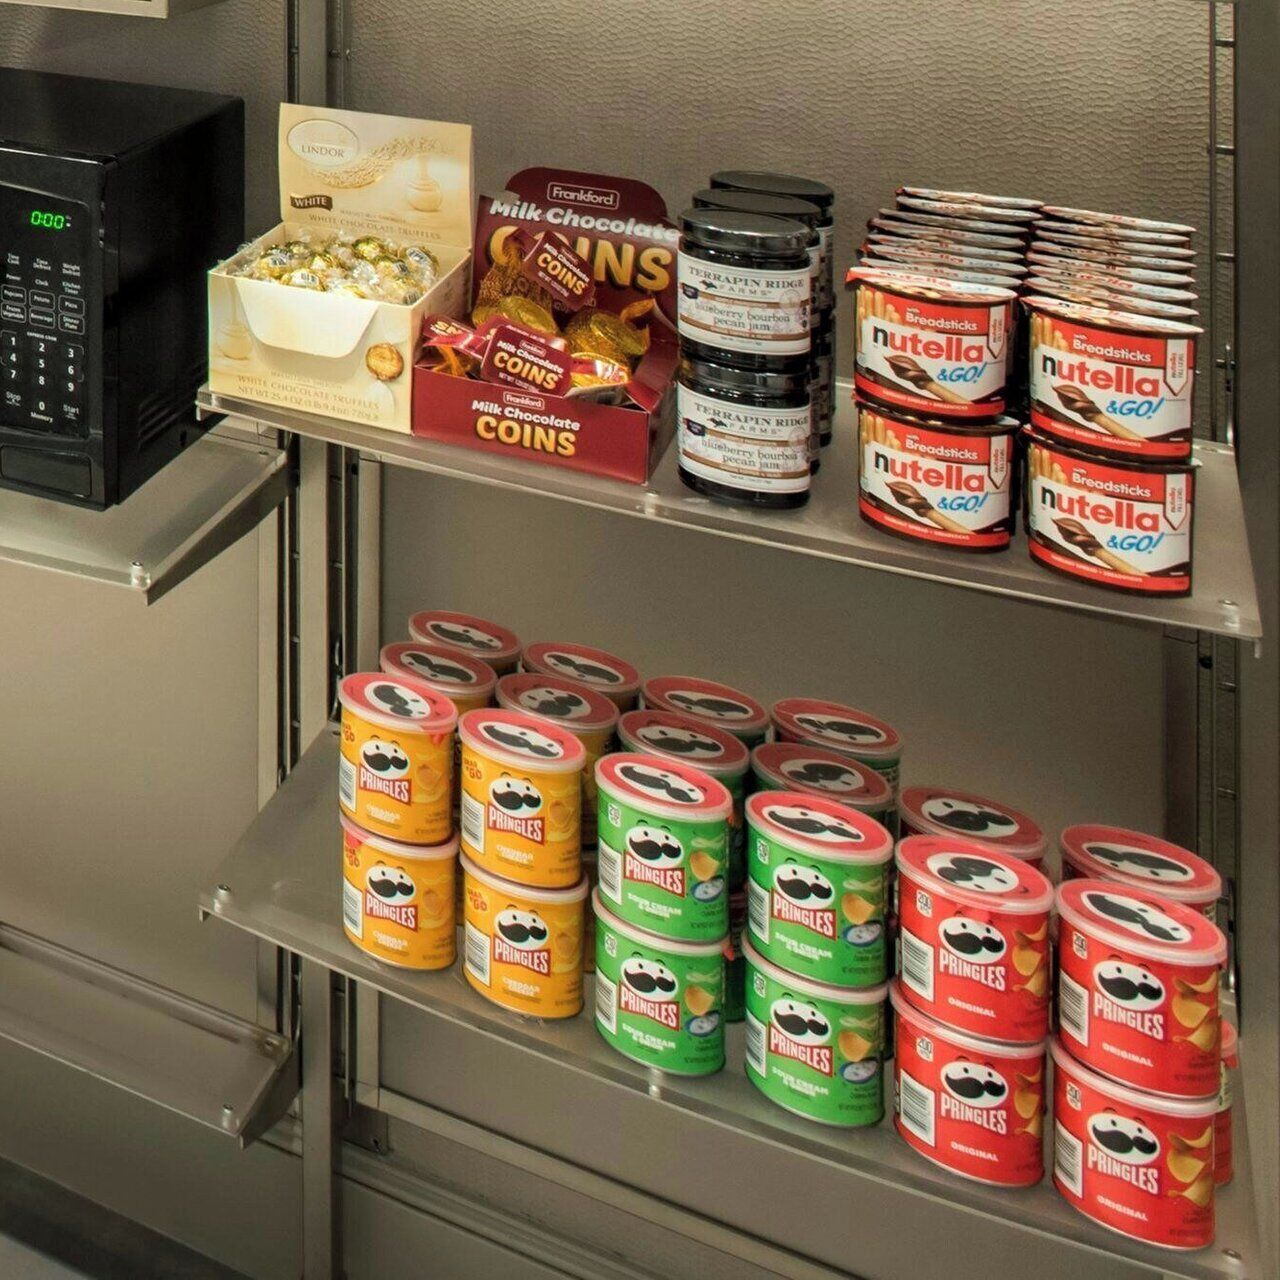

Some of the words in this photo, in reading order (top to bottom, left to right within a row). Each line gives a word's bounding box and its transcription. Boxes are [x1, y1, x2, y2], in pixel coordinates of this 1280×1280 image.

[301, 145, 344, 159] LINDOR
[293, 195, 328, 209] WHITE
[552, 187, 615, 206] Frankford
[31, 210, 65, 229] 0:00
[490, 200, 544, 222] Milk
[546, 207, 682, 242] Chocolate
[537, 252, 587, 296] COINS
[688, 265, 762, 288] TERRAPIN
[766, 278, 804, 289] RIDGE
[719, 284, 768, 296] FARMS
[713, 317, 744, 331] pecan
[746, 320, 771, 332] jam
[906, 312, 977, 331] Breadsticks
[10, 337, 16, 345] 1
[39, 343, 45, 352] 2
[68, 349, 74, 358] 3
[873, 325, 984, 363] nutella
[1073, 339, 1151, 364] Breadsticks
[10, 353, 17, 362] 4
[39, 359, 45, 368] 5
[68, 365, 74, 375] 6
[494, 350, 559, 390] COINS
[1042, 352, 1160, 398] nutella
[10, 370, 16, 379] 7
[39, 376, 45, 385] 8
[68, 383, 74, 392] 9
[39, 401, 46, 411] 0
[472, 399, 502, 417] Milk
[504, 406, 581, 432] Chocolate
[695, 402, 771, 427] TERRAPIN
[775, 414, 809, 427] RIDGE
[476, 416, 577, 458] COINS
[905, 439, 978, 461] Breadsticks
[874, 449, 985, 493] nutella
[1072, 472, 1151, 498] Breadsticks
[1041, 485, 1160, 532] nutella
[360, 767, 410, 804] PRINGLES
[489, 806, 544, 844] PRINGLES
[625, 854, 684, 897] PRINGLES
[366, 892, 416, 931] PRINGLES
[772, 894, 834, 938] PRINGLES
[494, 937, 550, 975] PRINGLES
[939, 950, 1007, 992] PRINGLES
[620, 985, 679, 1029] PRINGLES
[948, 996, 996, 1019] ORIGINAL
[1093, 994, 1166, 1042] PRINGLES
[770, 1027, 831, 1074] PRINGLES
[1101, 1041, 1154, 1068] ORIGINAL
[940, 1097, 1008, 1137] PRINGLES
[950, 1140, 999, 1163] ORIGINAL
[1087, 1148, 1160, 1196] PRINGLES
[1096, 1194, 1149, 1222] ORIGINAL
